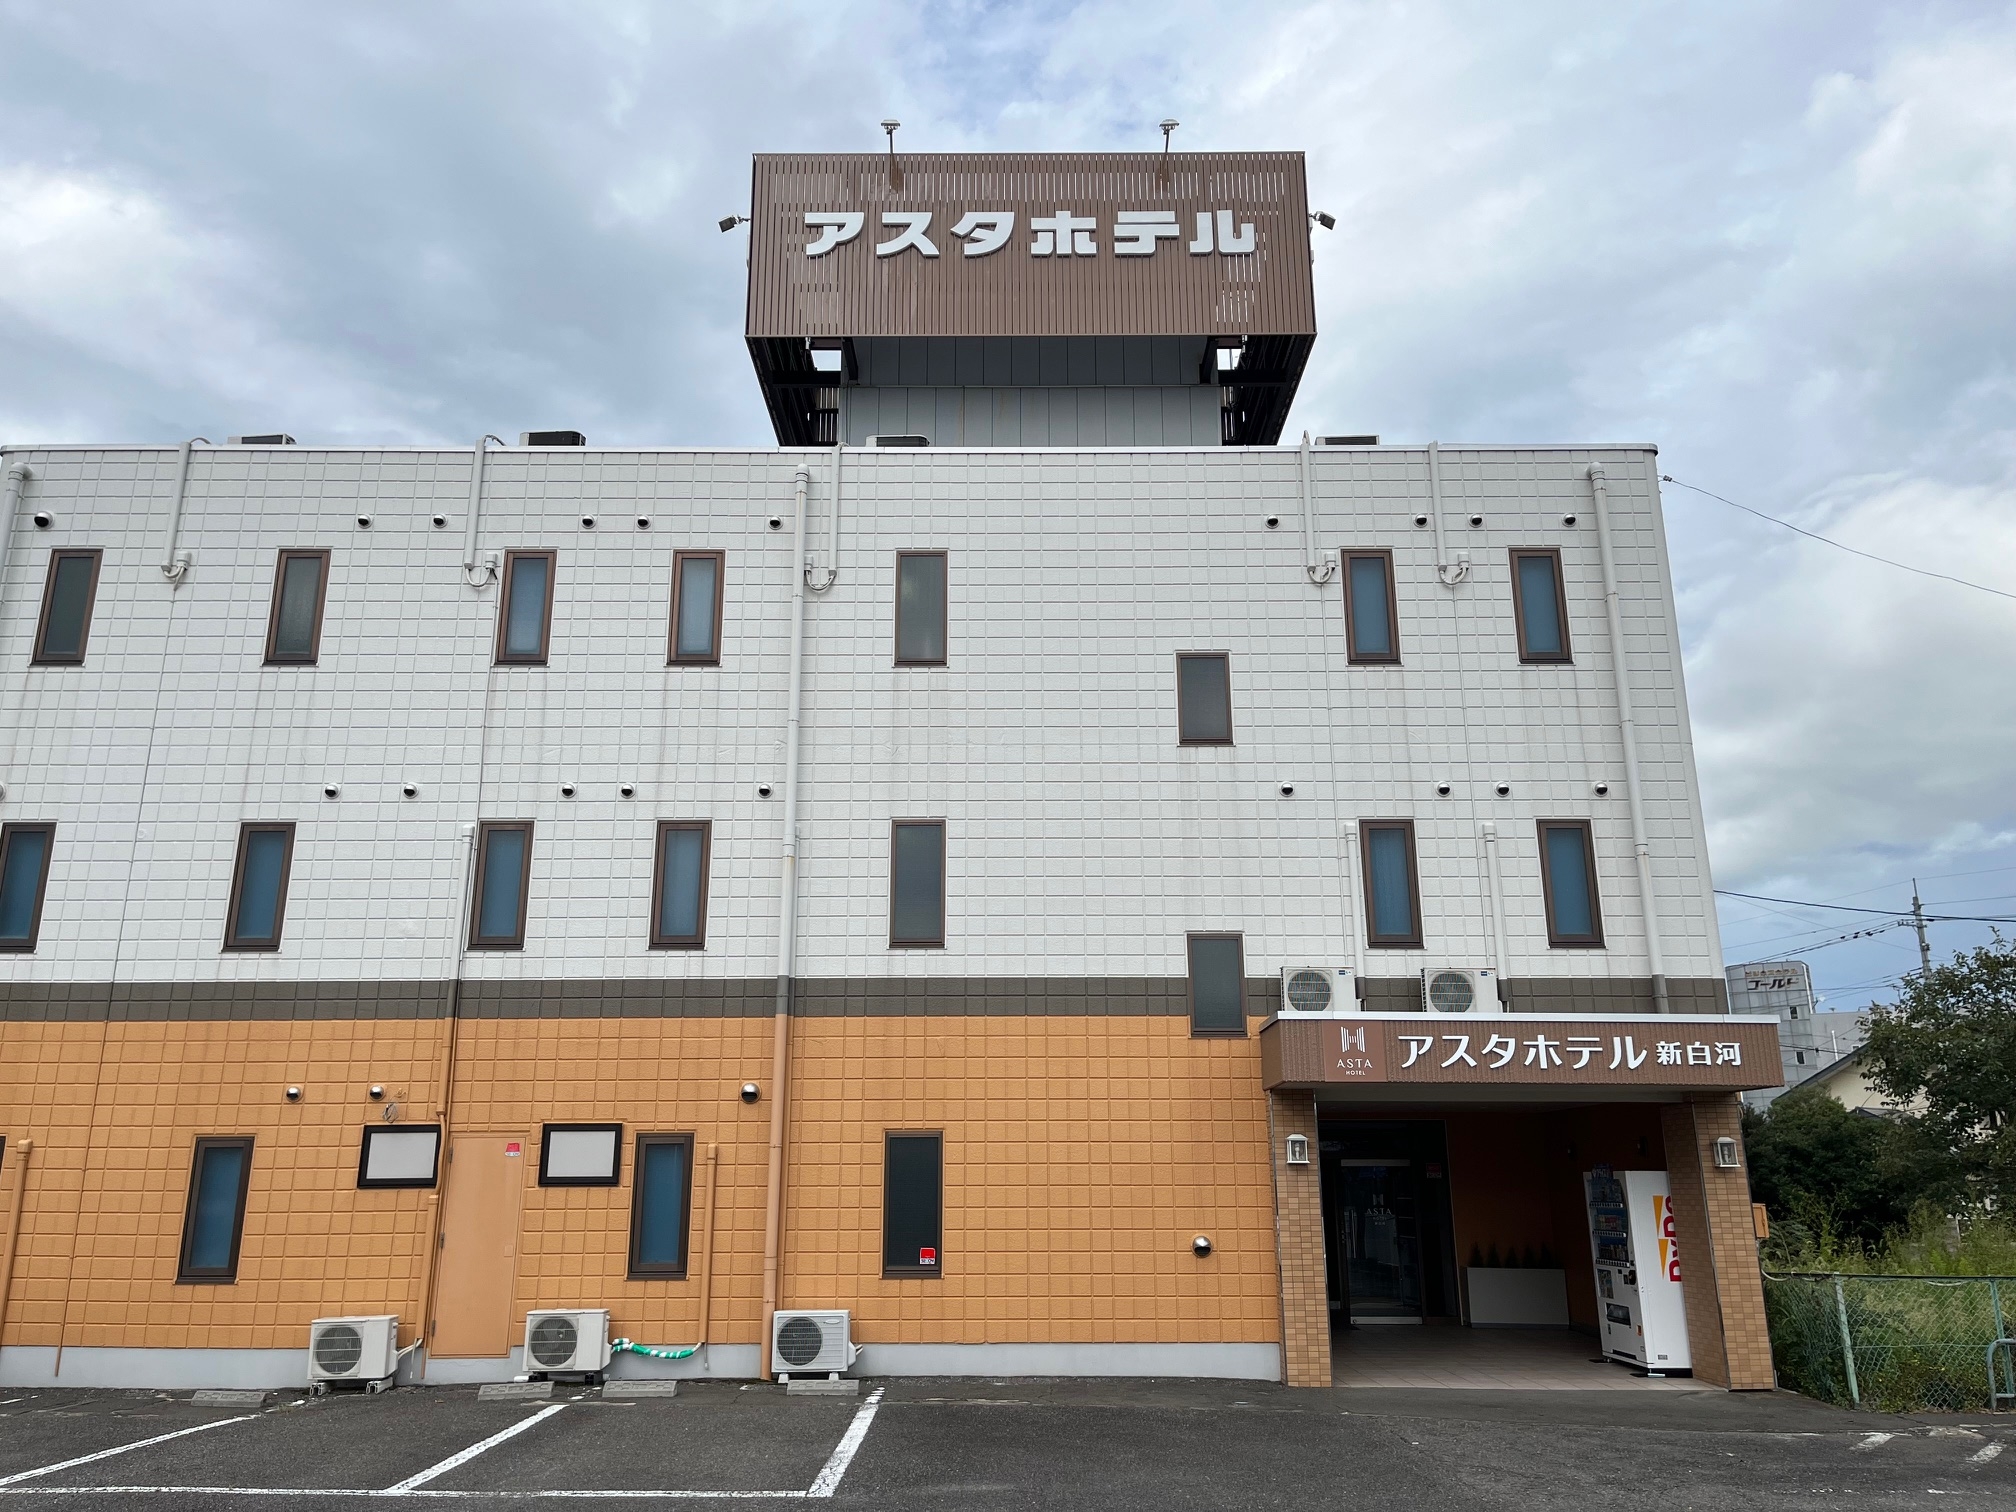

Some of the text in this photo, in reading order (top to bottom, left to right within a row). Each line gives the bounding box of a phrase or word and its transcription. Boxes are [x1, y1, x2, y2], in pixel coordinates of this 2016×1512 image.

[803, 209, 1256, 258] アスタホテル
[1336, 1058, 1373, 1069] ASTA
[1398, 1034, 1743, 1071] アスタホテル 新白河
[1366, 1207, 1392, 1216] ASTA
